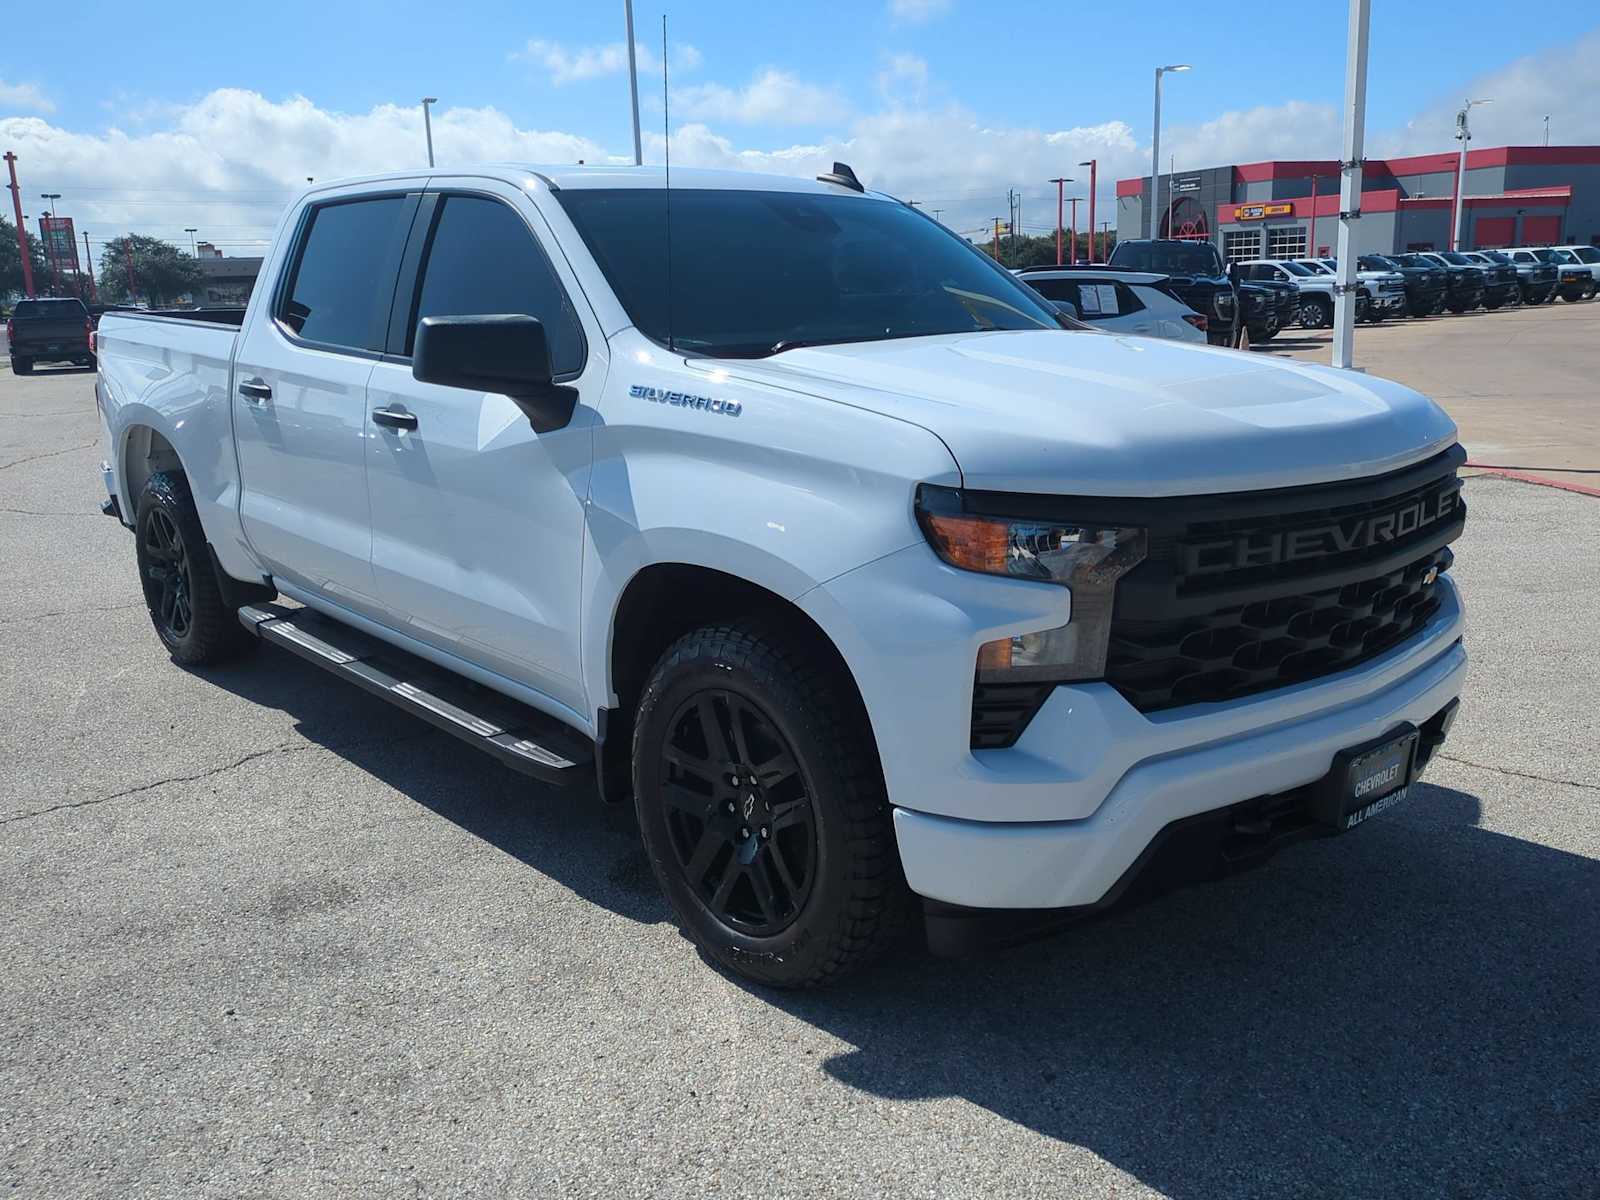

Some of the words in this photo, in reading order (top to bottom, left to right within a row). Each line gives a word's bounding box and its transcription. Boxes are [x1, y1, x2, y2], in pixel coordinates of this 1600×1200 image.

[629, 384, 742, 417] SILVERADO
[1354, 763, 1401, 798] CHEVROLET
[1346, 809, 1363, 829] ALL
[1364, 786, 1408, 820] AMERICAN
